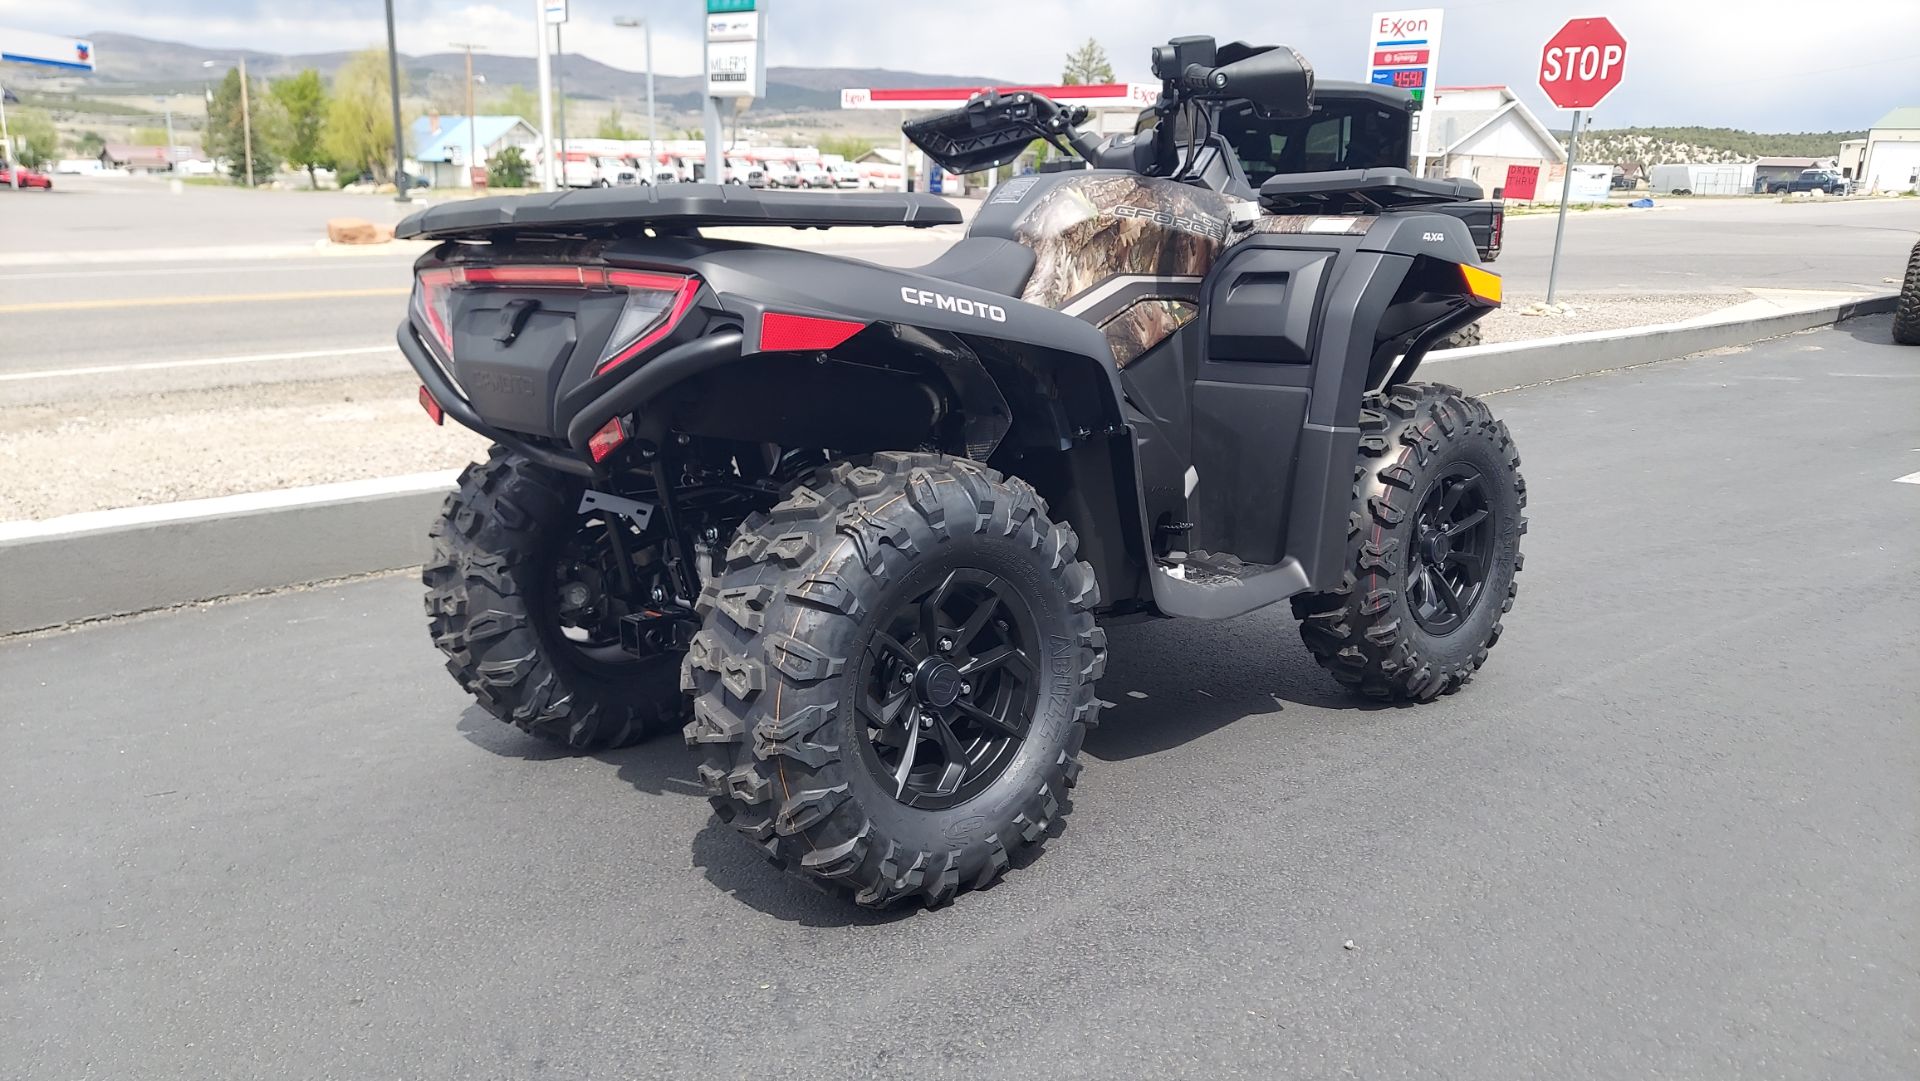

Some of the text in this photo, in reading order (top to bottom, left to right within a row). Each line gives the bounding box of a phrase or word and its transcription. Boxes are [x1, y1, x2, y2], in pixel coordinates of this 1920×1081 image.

[1379, 18, 1428, 38] Exxon
[1543, 45, 1622, 82] STOP
[1507, 176, 1534, 186] THRU
[1510, 166, 1538, 175] DRIVE
[1113, 204, 1223, 241] CFORCE
[901, 286, 1007, 322] CFMOTO
